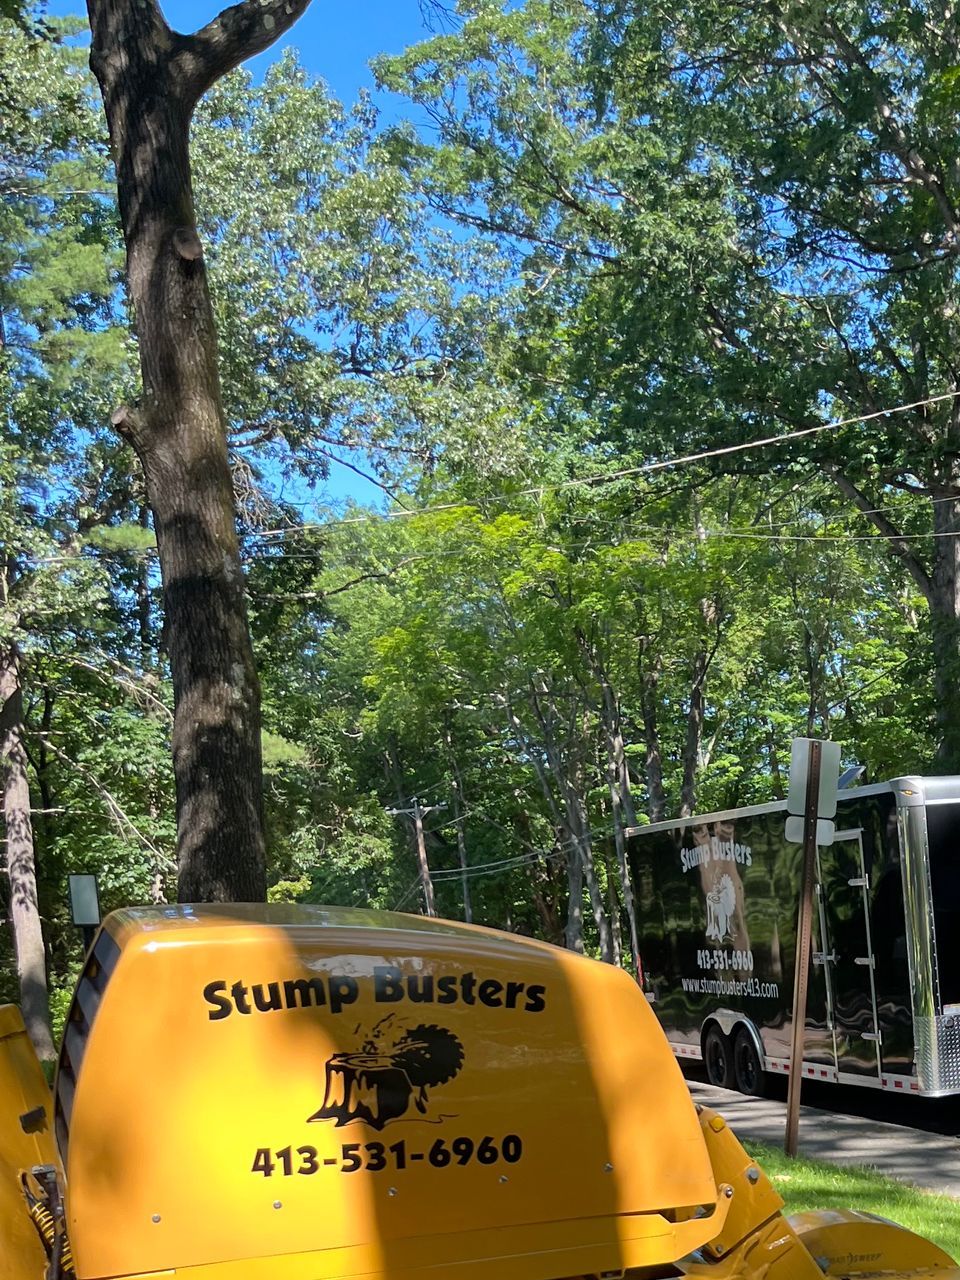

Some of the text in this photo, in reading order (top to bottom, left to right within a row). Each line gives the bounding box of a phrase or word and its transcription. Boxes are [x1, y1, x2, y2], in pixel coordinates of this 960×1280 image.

[681, 836, 752, 873] Stump Busters
[697, 949, 754, 971] 413-531-6960
[203, 966, 546, 1021] Stump Busters
[682, 976, 779, 999] www.stumpbusters413.com
[251, 1134, 522, 1178] 413-531-6960
